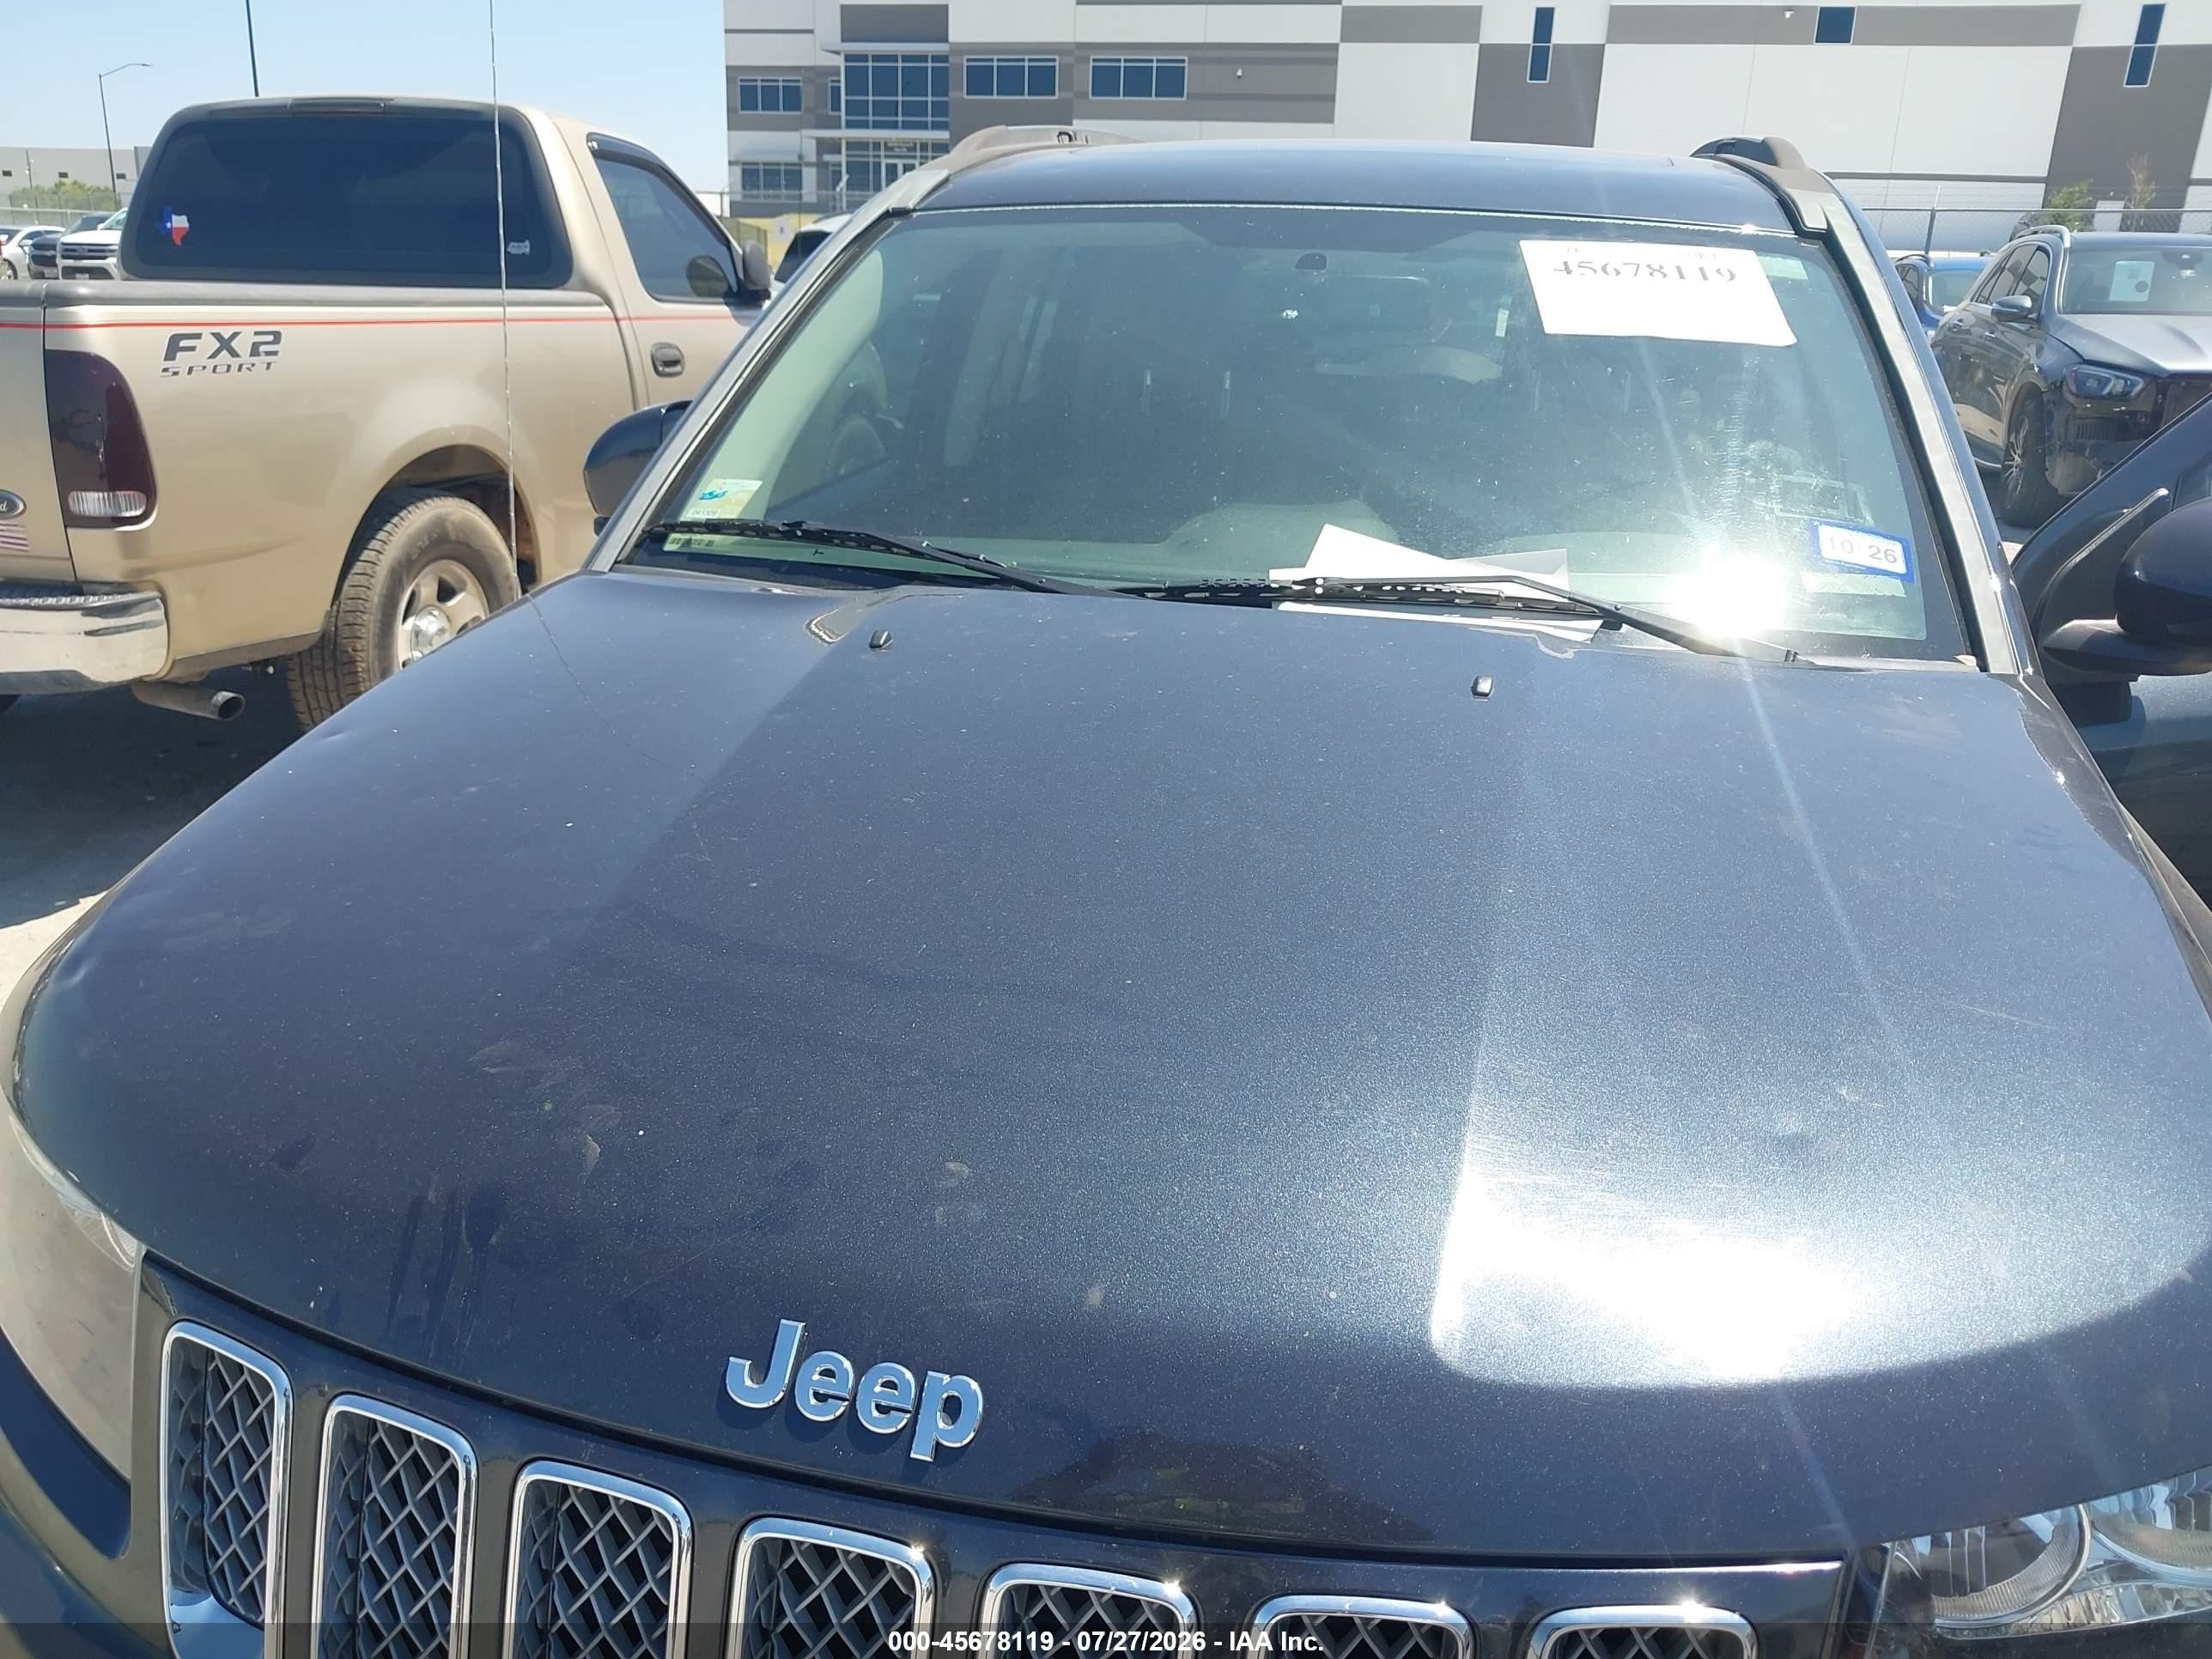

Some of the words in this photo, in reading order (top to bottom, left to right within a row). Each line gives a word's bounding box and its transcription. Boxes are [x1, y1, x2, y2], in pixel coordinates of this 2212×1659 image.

[1553, 260, 1736, 283] 45678119
[163, 330, 283, 362] FX2
[160, 361, 278, 378] SPORT
[1868, 544, 1898, 564] 26
[726, 1318, 983, 1462] Jeep
